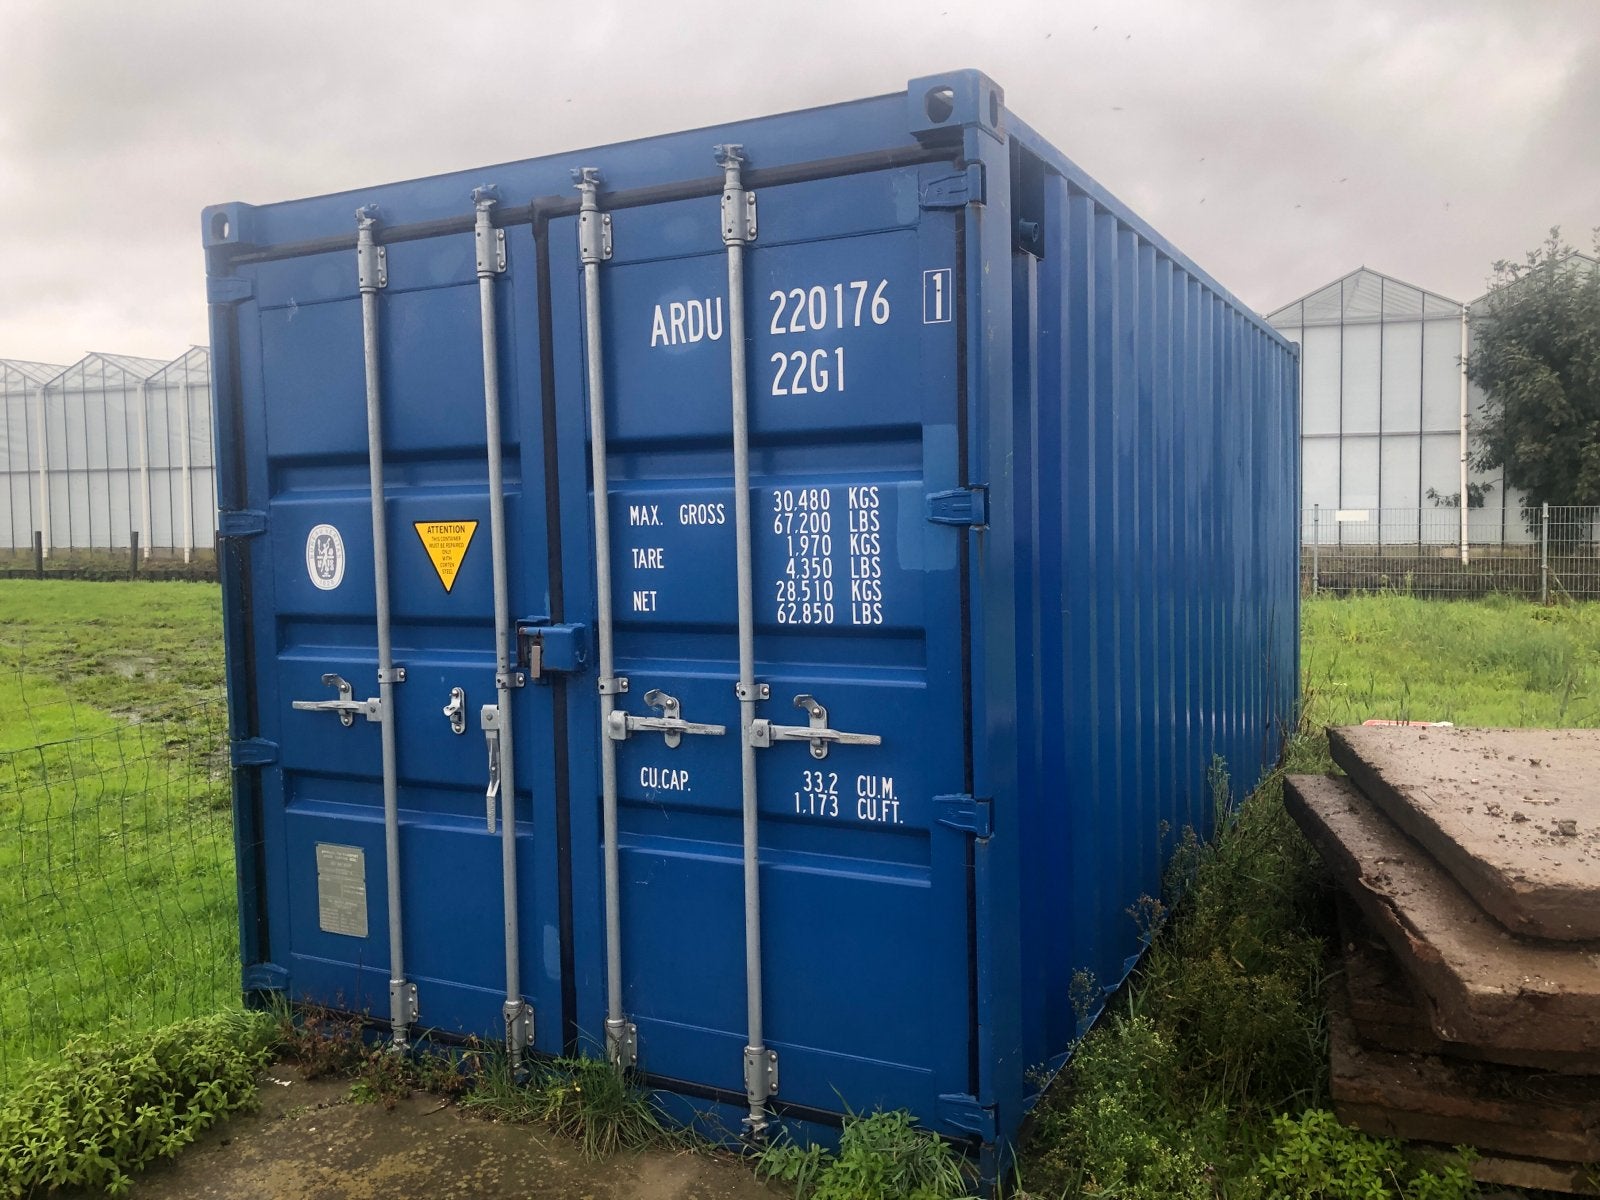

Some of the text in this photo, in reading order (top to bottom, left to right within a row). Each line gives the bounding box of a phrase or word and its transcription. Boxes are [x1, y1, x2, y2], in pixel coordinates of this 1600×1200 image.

[651, 297, 723, 347] ARDU
[769, 279, 890, 335] 220176
[770, 346, 844, 396] 22G1
[773, 486, 879, 512] 30,480 KGS
[629, 503, 725, 526] MAX. GROSS
[773, 510, 880, 534] 67,200 LBS
[427, 525, 465, 534] ATTENTION
[786, 533, 881, 557] 1,970 KGS
[632, 548, 665, 569] TARE
[786, 556, 882, 580] 4,350 LBS
[633, 591, 657, 612] NET
[775, 579, 882, 603] 28,510 KGS
[776, 602, 883, 625] 62,850 LBS
[640, 767, 691, 792] CU.CAP.
[803, 770, 898, 800] 33.2 CU.M.
[794, 791, 904, 824] 1,173 CU.FT.
